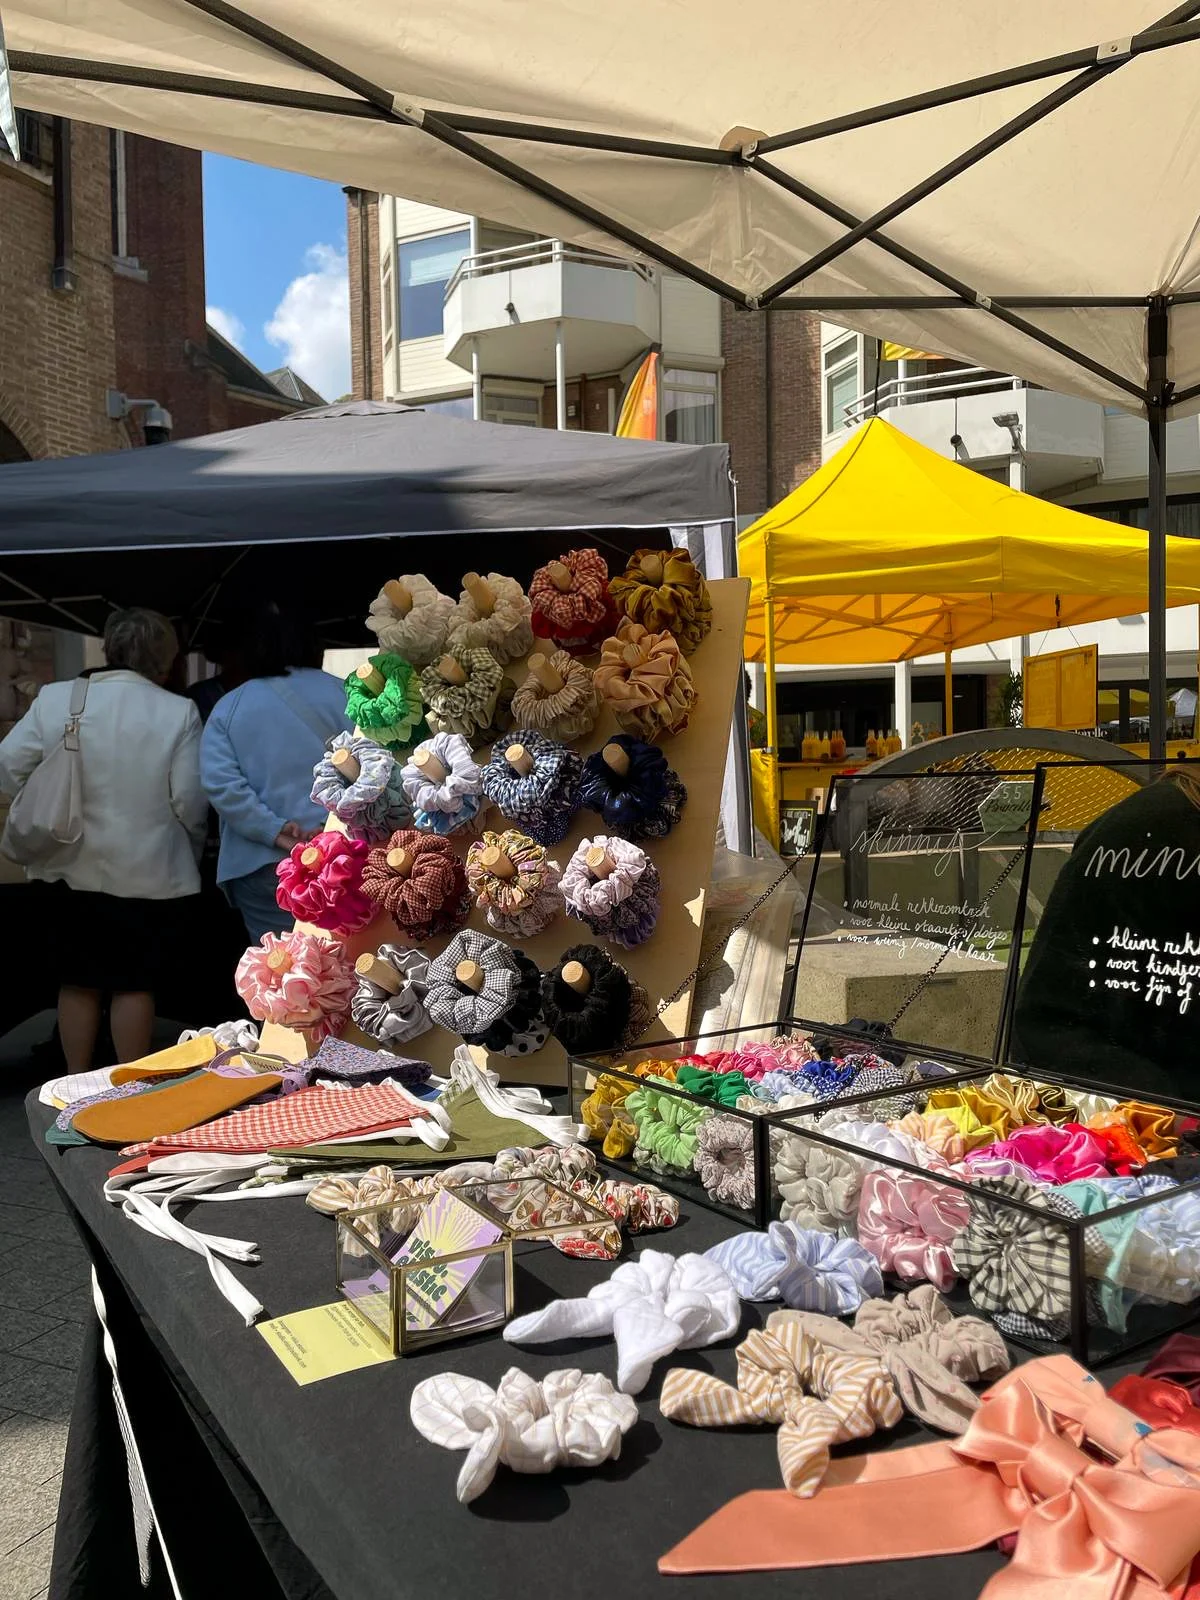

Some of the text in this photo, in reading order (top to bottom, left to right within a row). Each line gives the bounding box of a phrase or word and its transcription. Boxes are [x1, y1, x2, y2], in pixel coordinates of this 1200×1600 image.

[850, 816, 1006, 877] skinny
[853, 893, 901, 911] normale
[850, 917, 873, 928] voor
[877, 913, 911, 931] kleine
[846, 934, 869, 945] voor
[874, 934, 908, 960] weinig
[965, 943, 1000, 963] haar
[1106, 925, 1200, 956] kleine rek
[1106, 958, 1140, 973] voor
[1104, 974, 1193, 1015] voor fijn of
